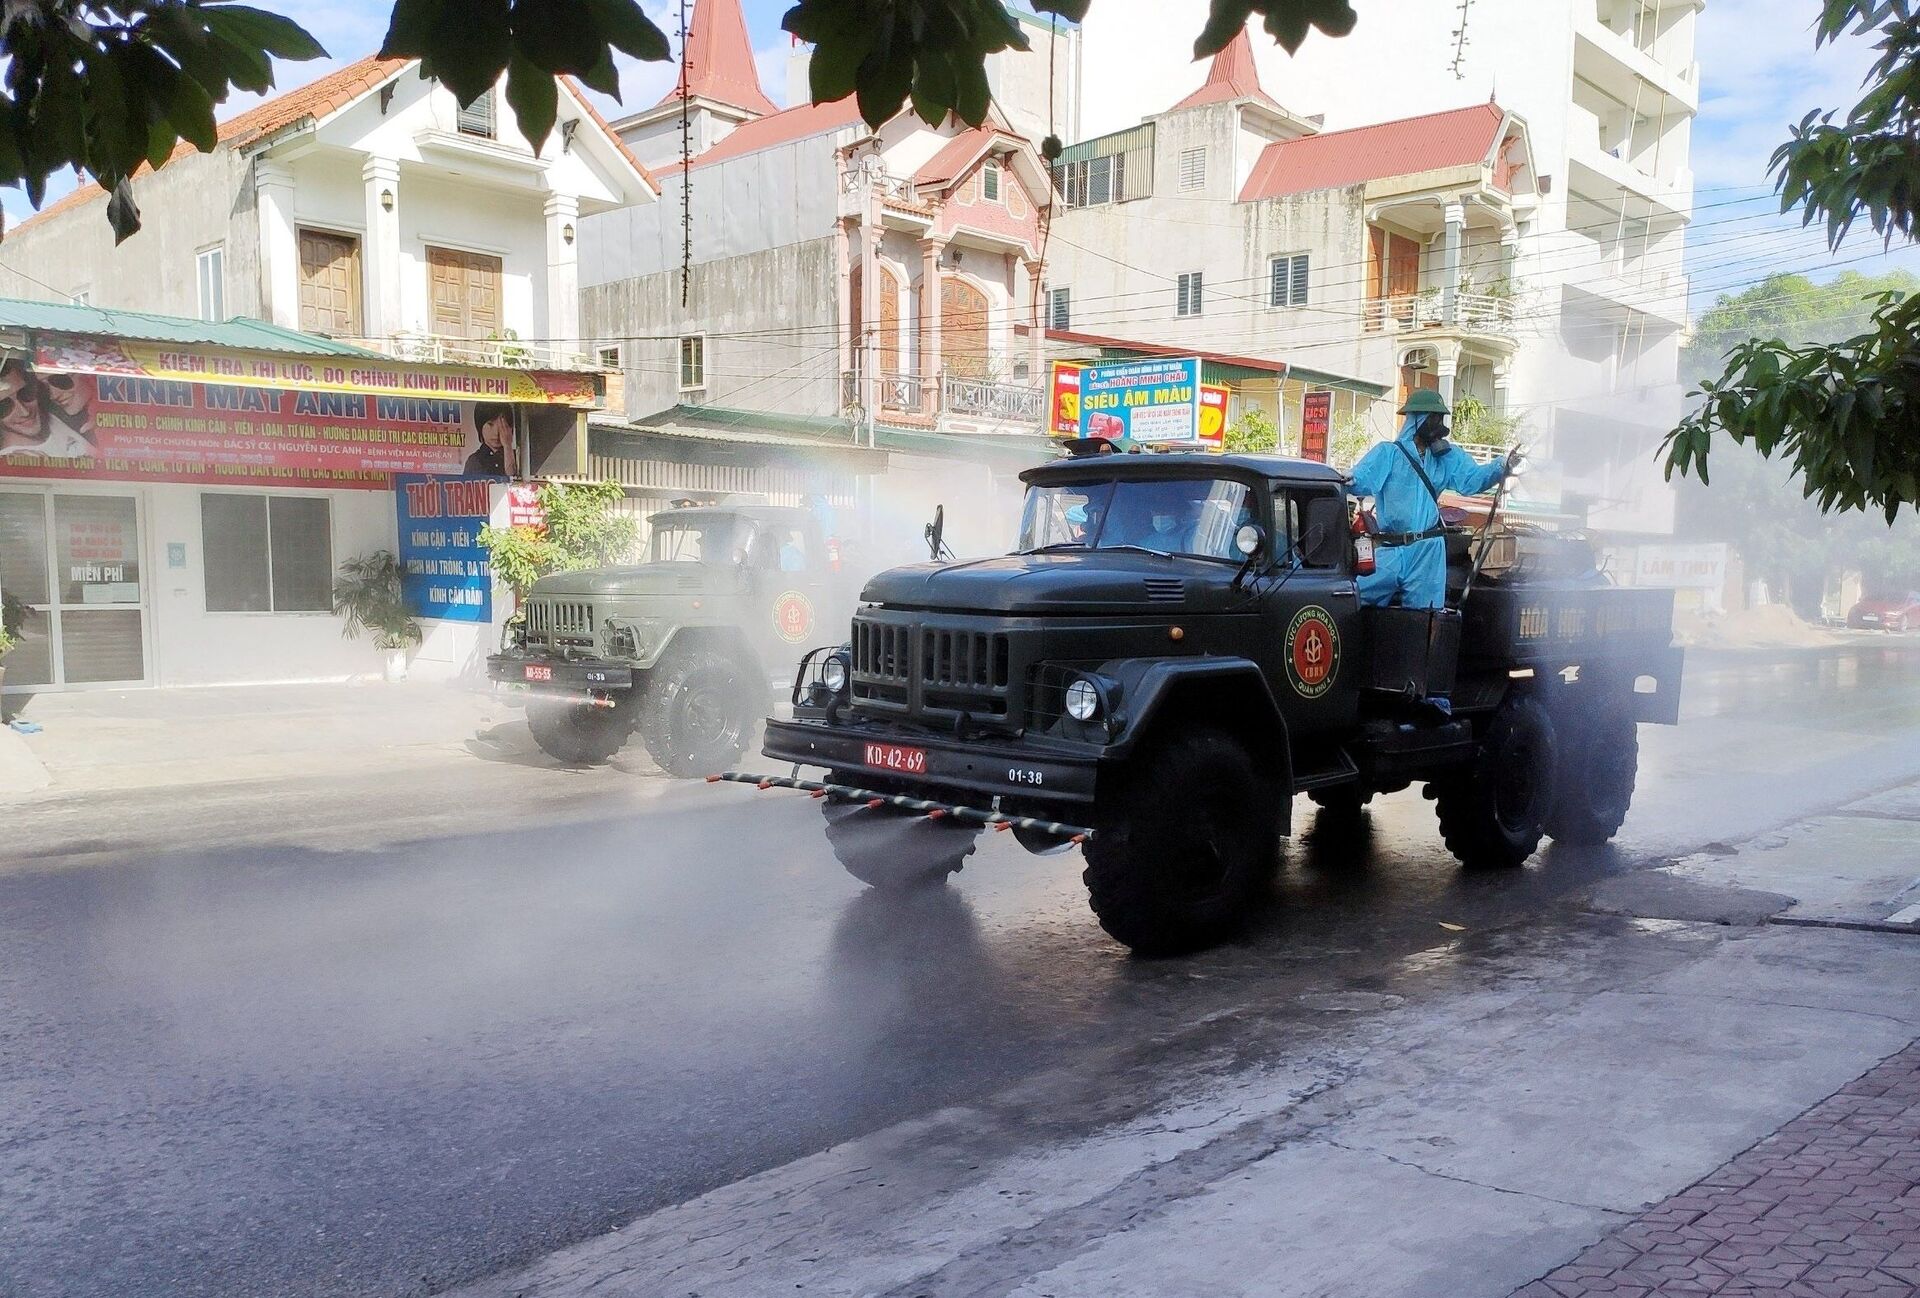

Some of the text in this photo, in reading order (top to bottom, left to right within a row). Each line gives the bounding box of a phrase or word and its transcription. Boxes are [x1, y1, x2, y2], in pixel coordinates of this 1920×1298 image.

[212, 357, 244, 376] TRA
[251, 360, 276, 383] THỊ
[323, 367, 345, 385] ĐO
[403, 368, 440, 391] KÍNH
[486, 376, 509, 395] PHÍ
[1110, 374, 1139, 388] HOÀNG
[1139, 372, 1163, 386] MINH
[1163, 369, 1188, 384] CHÂU
[1083, 391, 1119, 410] SIÊU
[1123, 389, 1149, 407] ÂM
[1154, 384, 1192, 404] MÀU
[293, 389, 368, 420] ANH
[376, 395, 462, 426] MINH
[224, 438, 244, 450] BÁC
[258, 441, 271, 451] CK
[278, 439, 318, 453] NGUYỄN
[320, 443, 340, 454] ĐỨC
[341, 446, 362, 455] ANH
[388, 430, 400, 447] TRỊ
[406, 474, 443, 518] THỜI
[411, 529, 429, 547] KÍNH
[430, 529, 446, 550] CẬN
[104, 564, 123, 581] PHÍ
[425, 560, 437, 575] HAI
[429, 584, 447, 604] KÍNH
[866, 745, 924, 772] KD-42-69
[1008, 768, 1044, 785] 01-38
